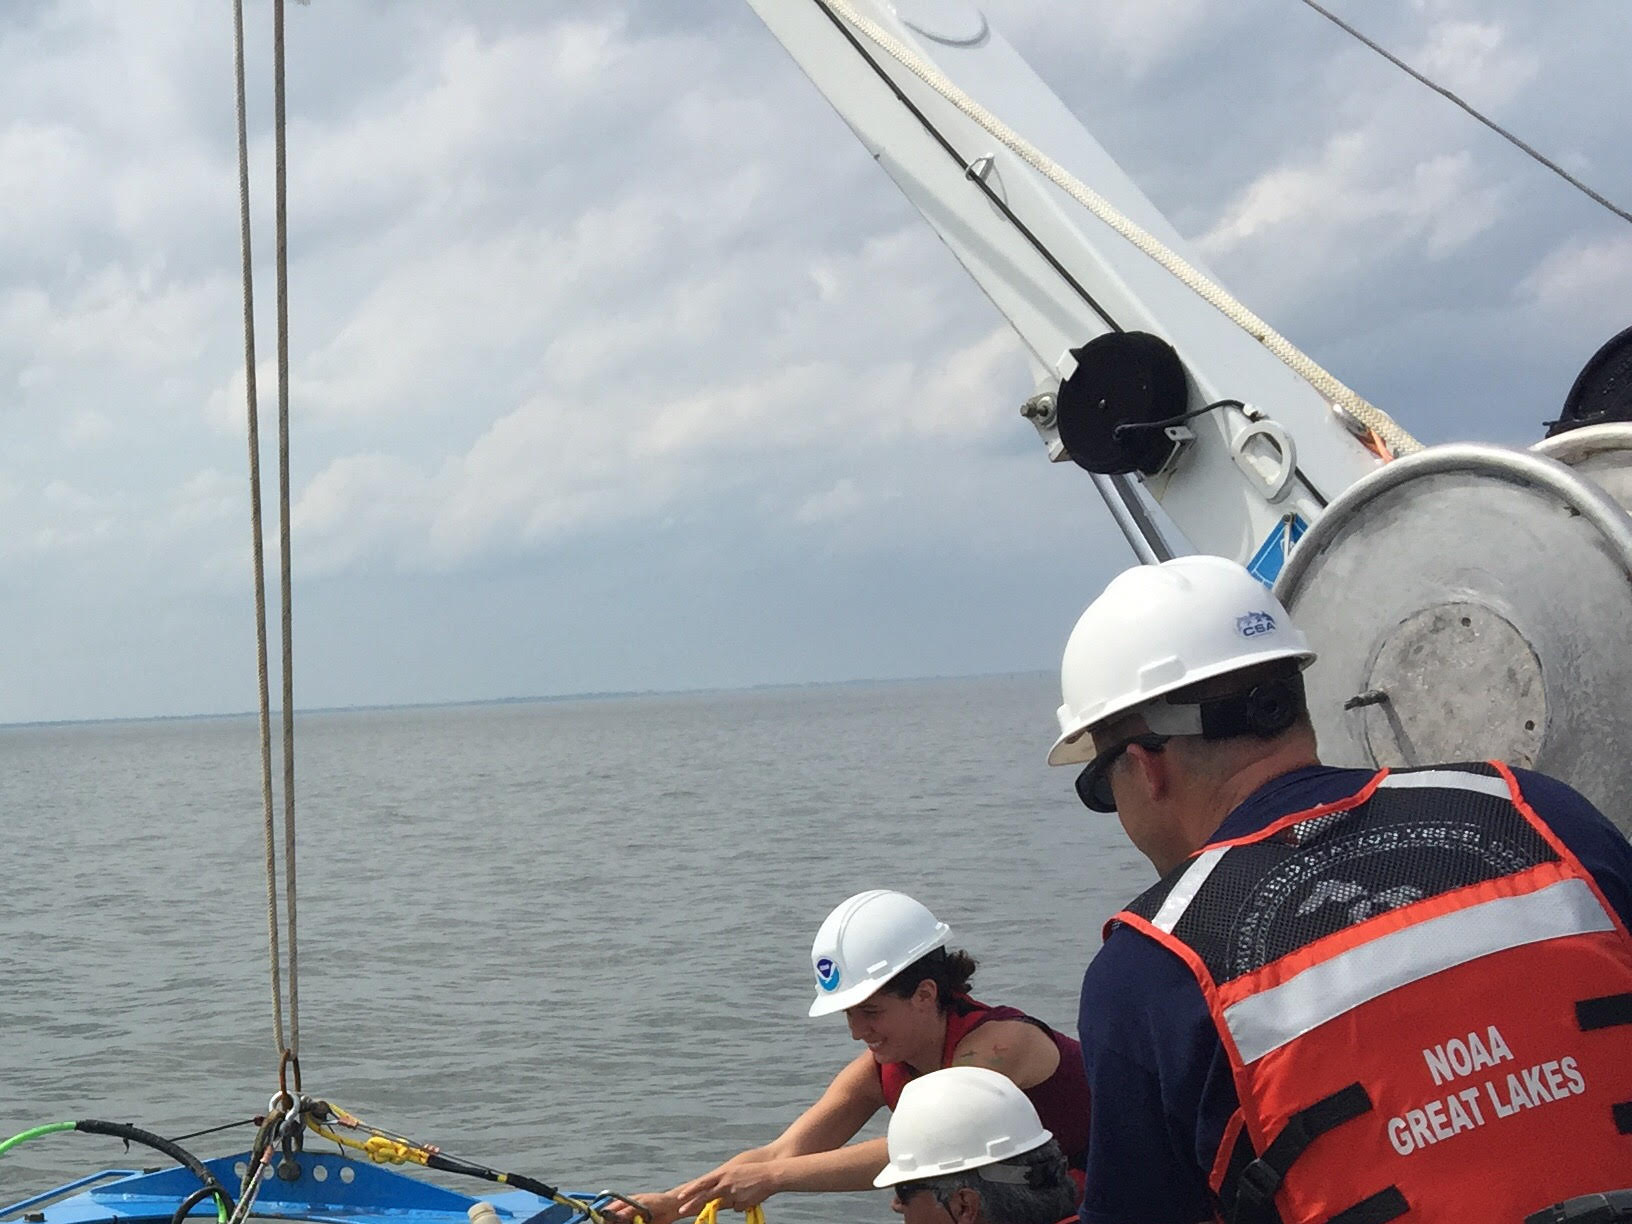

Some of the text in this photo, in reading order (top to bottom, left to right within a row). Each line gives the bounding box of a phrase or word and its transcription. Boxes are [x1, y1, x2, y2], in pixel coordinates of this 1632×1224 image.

[1423, 1025, 1514, 1086] NOAA
[1387, 1056, 1586, 1156] GREAT LAKES
